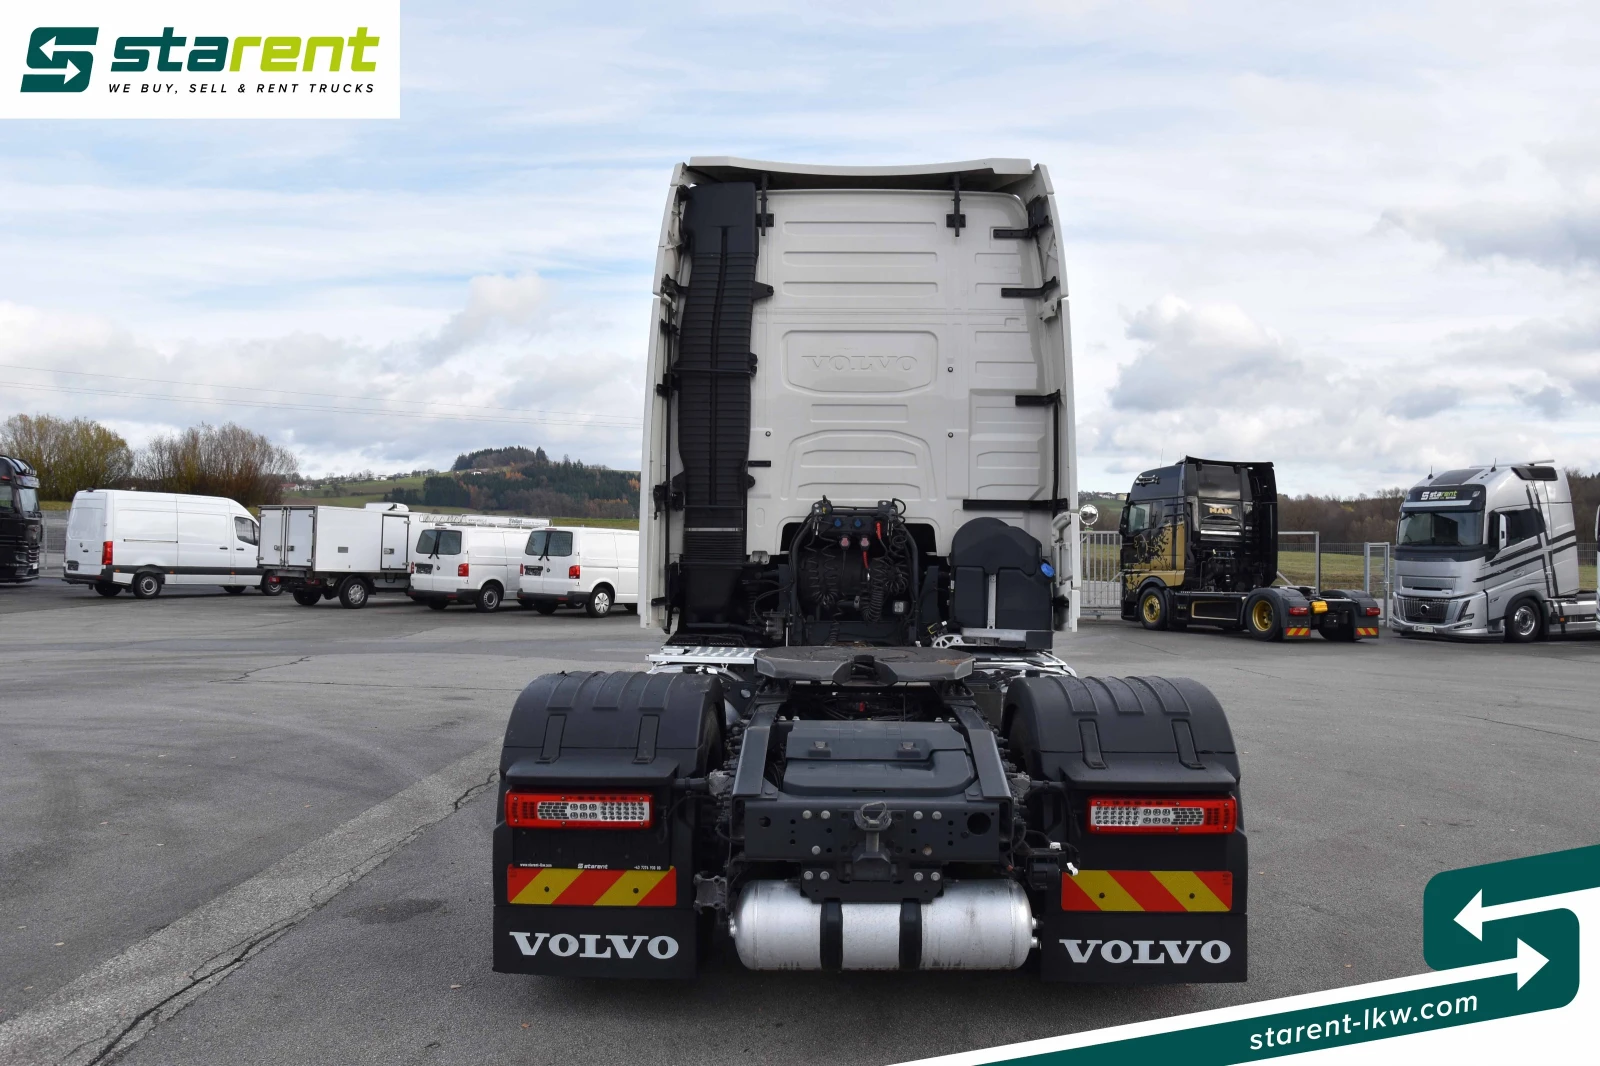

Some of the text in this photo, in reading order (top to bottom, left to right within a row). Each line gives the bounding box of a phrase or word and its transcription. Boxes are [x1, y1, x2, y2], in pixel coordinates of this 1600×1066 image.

[800, 355, 918, 371] VOLVO
[509, 931, 679, 960] VOLVO
[1058, 938, 1231, 964] VOLVO
